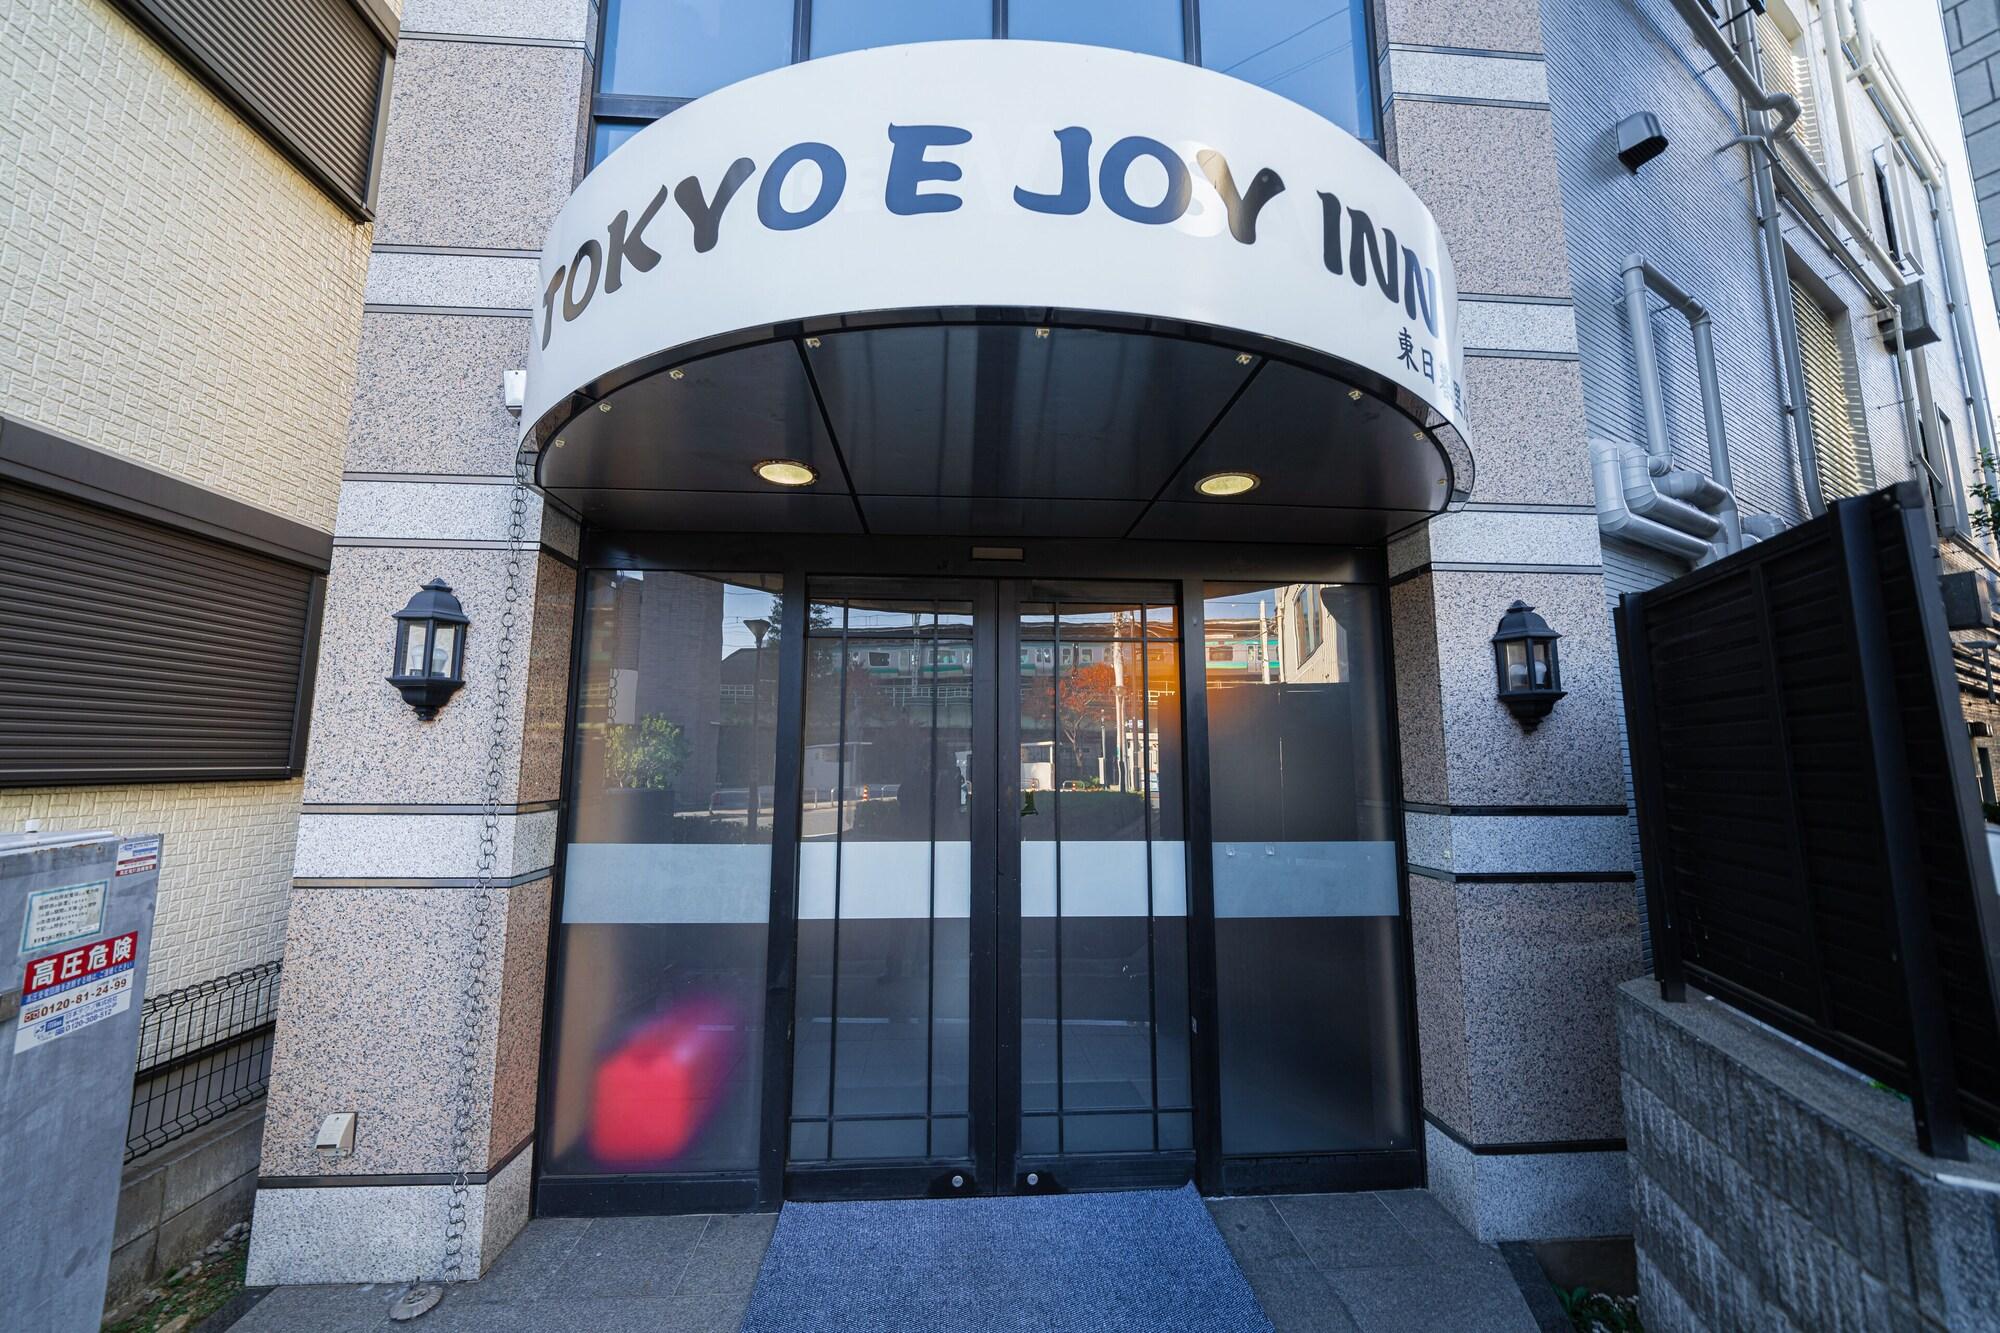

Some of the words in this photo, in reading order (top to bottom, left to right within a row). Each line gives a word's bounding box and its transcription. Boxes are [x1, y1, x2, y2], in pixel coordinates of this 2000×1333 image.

[541, 142, 846, 351] TOKYO
[884, 121, 973, 216] E
[1013, 124, 1287, 245] JOY
[1315, 190, 1439, 339] INN
[31, 936, 133, 990] 高圧危険
[41, 979, 127, 1017] 0120-81-24-99
